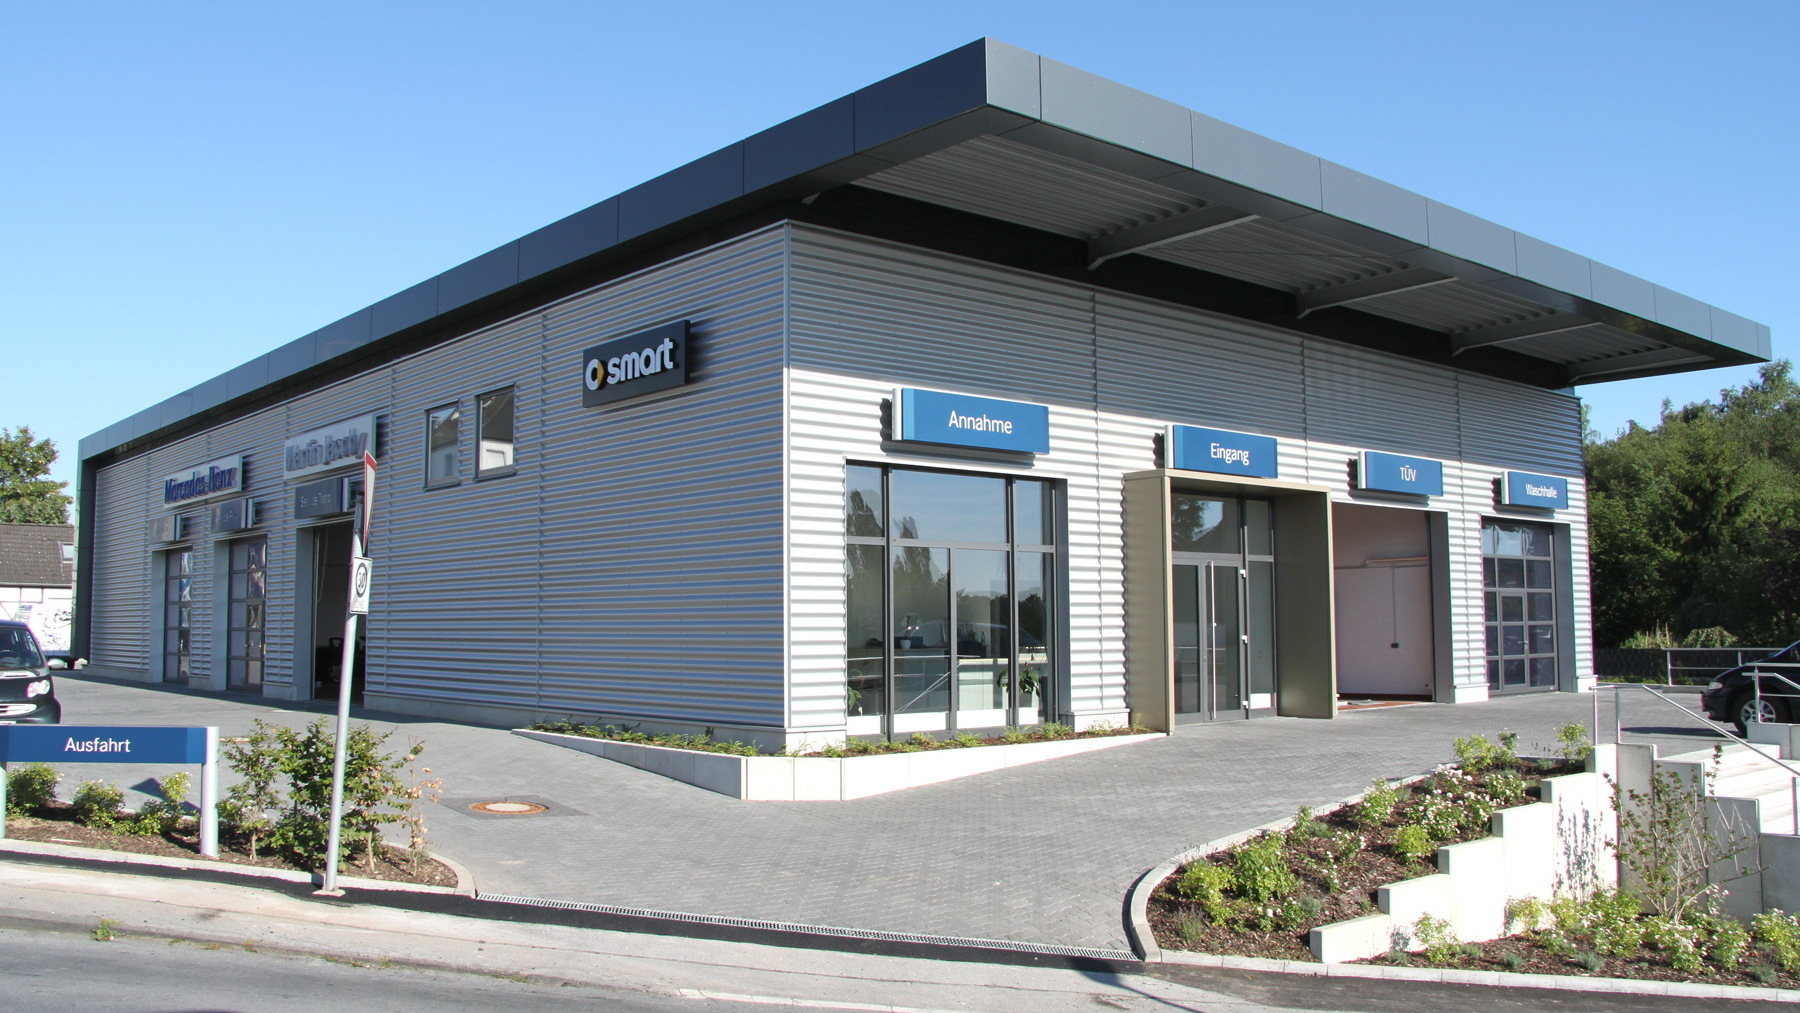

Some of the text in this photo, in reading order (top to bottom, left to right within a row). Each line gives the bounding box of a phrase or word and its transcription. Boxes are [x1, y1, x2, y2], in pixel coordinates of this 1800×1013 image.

[606, 338, 674, 384] smart
[948, 410, 1013, 435] Annahme
[1210, 442, 1250, 466] Eingang
[165, 466, 237, 504] Mercedes-Benz
[1399, 464, 1417, 482] TÜV
[1525, 483, 1558, 499] Waschhalle
[64, 736, 131, 753] Ausfahrt
